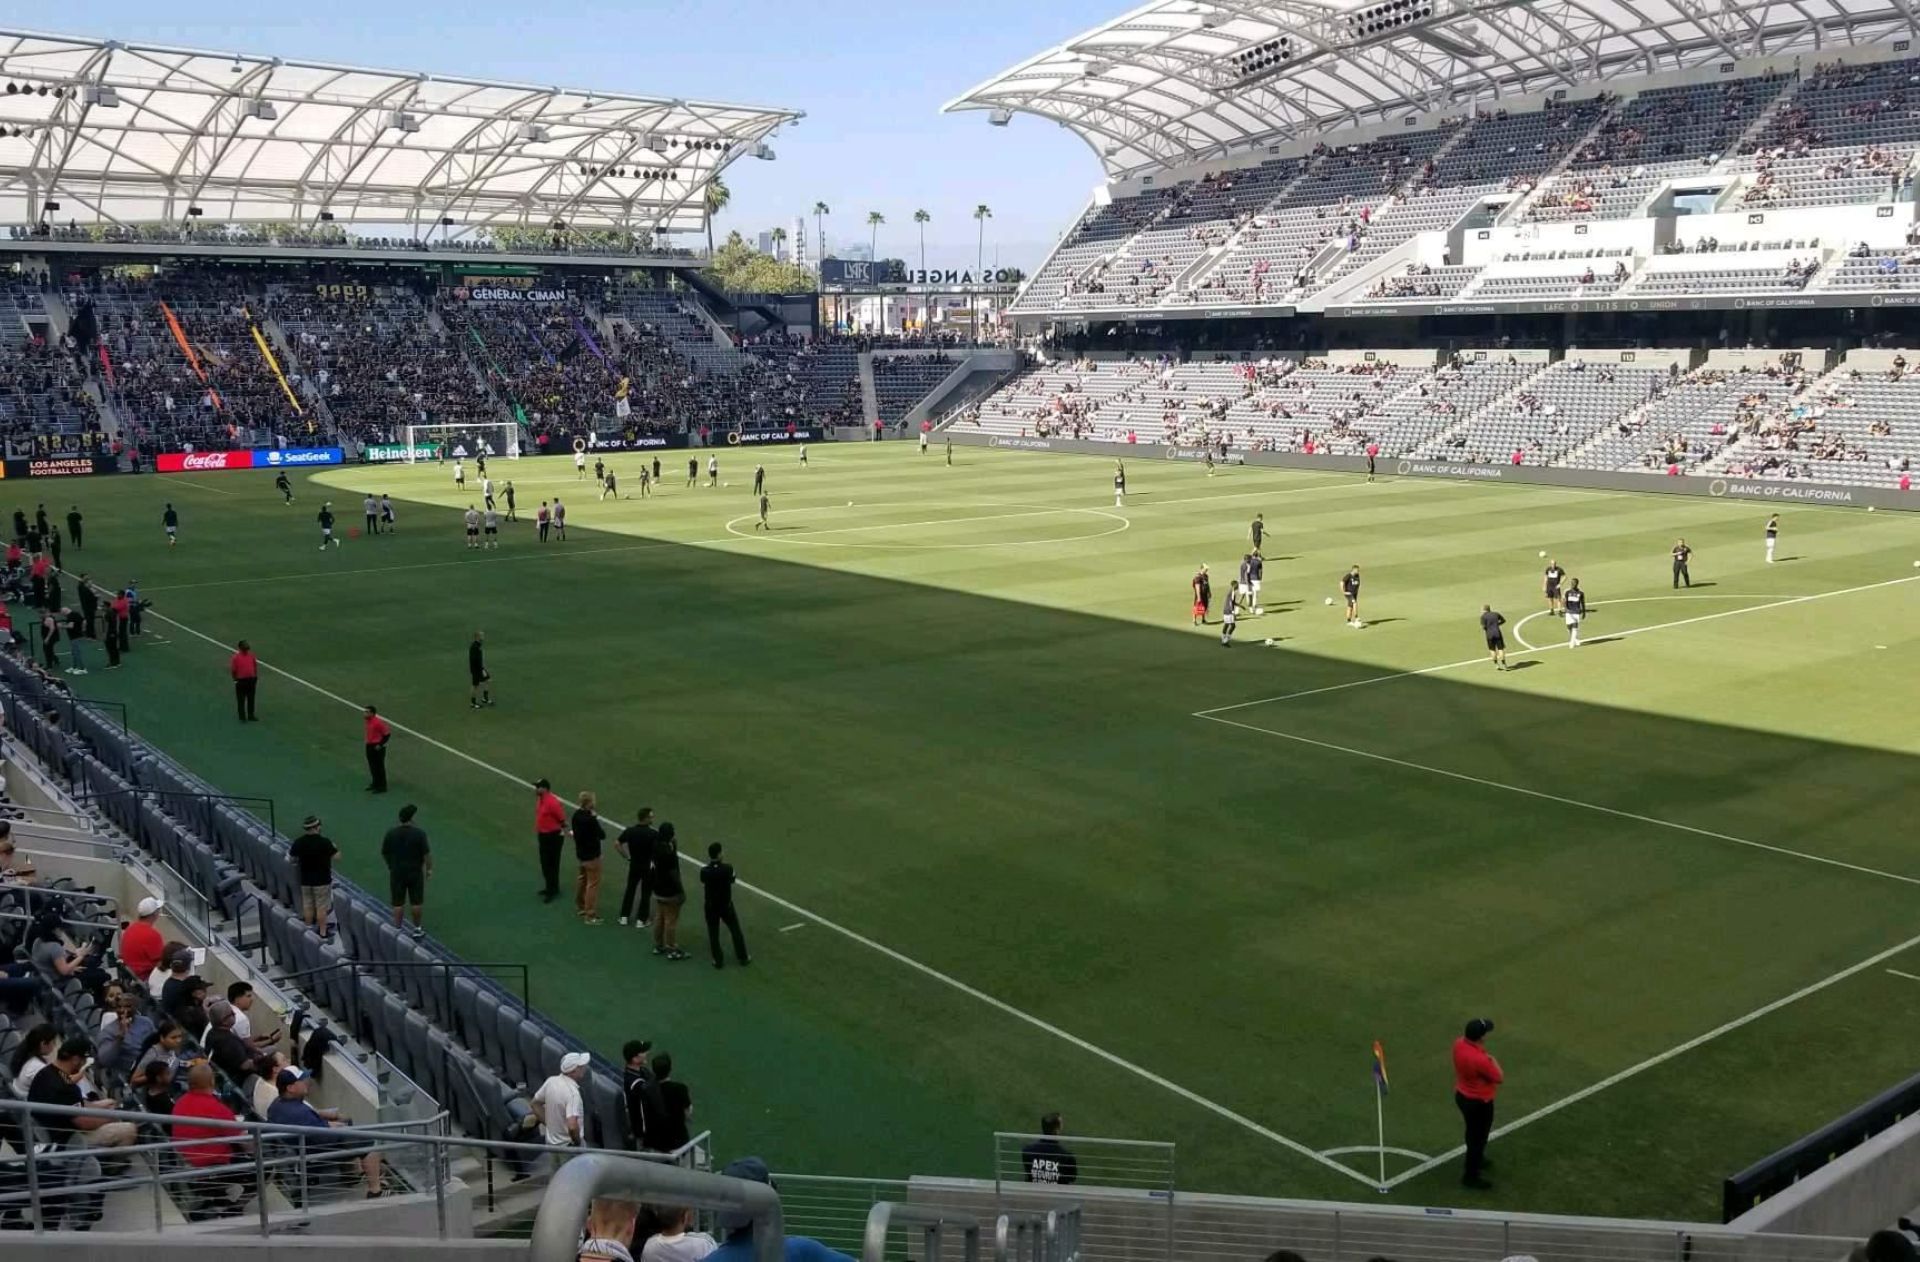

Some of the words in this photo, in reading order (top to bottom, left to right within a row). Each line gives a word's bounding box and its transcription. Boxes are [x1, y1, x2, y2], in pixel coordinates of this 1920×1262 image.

[472, 288, 525, 300] GENERAL
[526, 289, 566, 301] CIMAN
[30, 461, 49, 469] LOS
[50, 459, 93, 468] ANGELES
[284, 452, 331, 463] SeatGeek
[30, 468, 71, 476] FOOTBALL
[72, 467, 93, 475] CLUB
[1412, 464, 1436, 473] BANC
[1437, 465, 1450, 474] OF
[1451, 466, 1502, 478] CALIFORNIA
[1730, 484, 1761, 496] BANC
[1764, 486, 1780, 496] OF
[1782, 487, 1852, 501] CALIFORNIA
[1032, 1159, 1059, 1172] APEX
